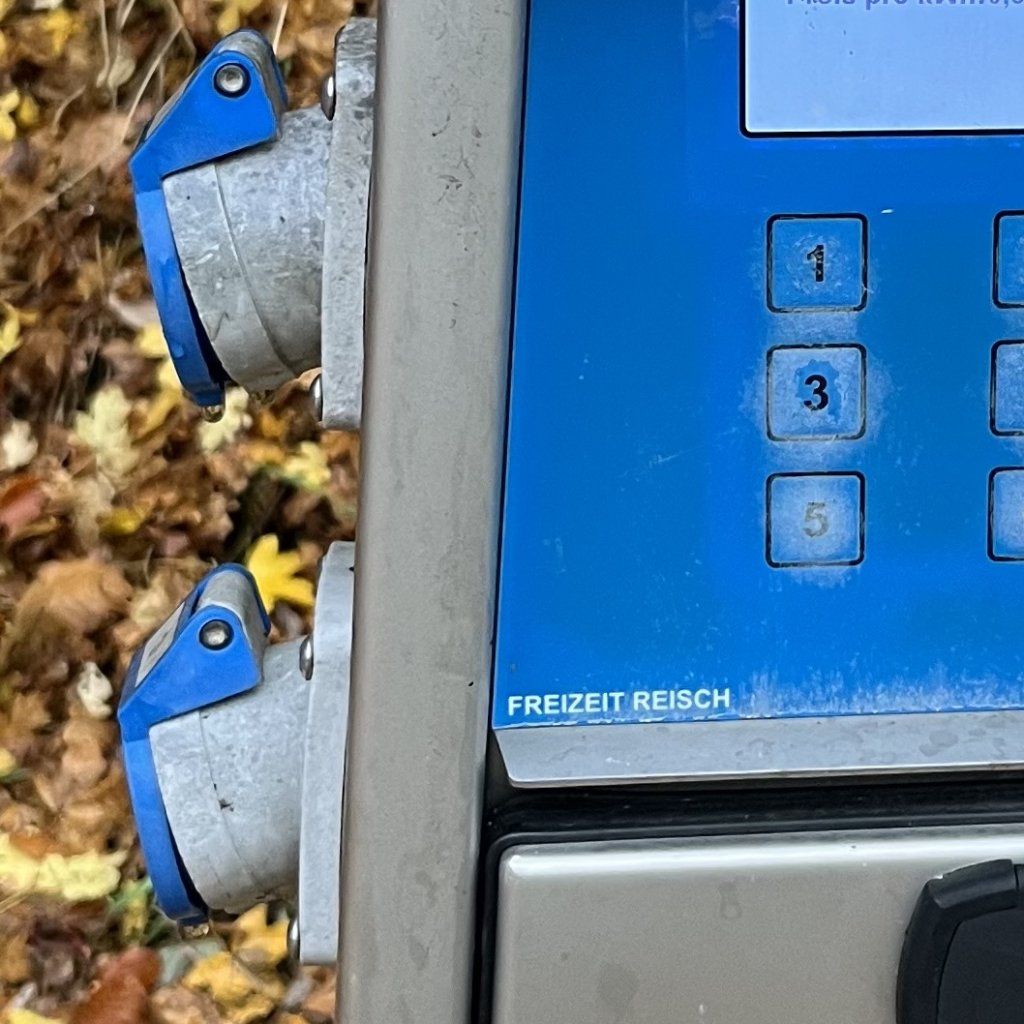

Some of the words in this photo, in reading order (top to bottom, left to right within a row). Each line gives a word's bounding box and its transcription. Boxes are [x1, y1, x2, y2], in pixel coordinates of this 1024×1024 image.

[806, 244, 825, 282] 1
[803, 374, 828, 410] 3
[803, 501, 829, 537] 5
[508, 692, 625, 716] FREIZEIT
[633, 688, 731, 711] REISCH
